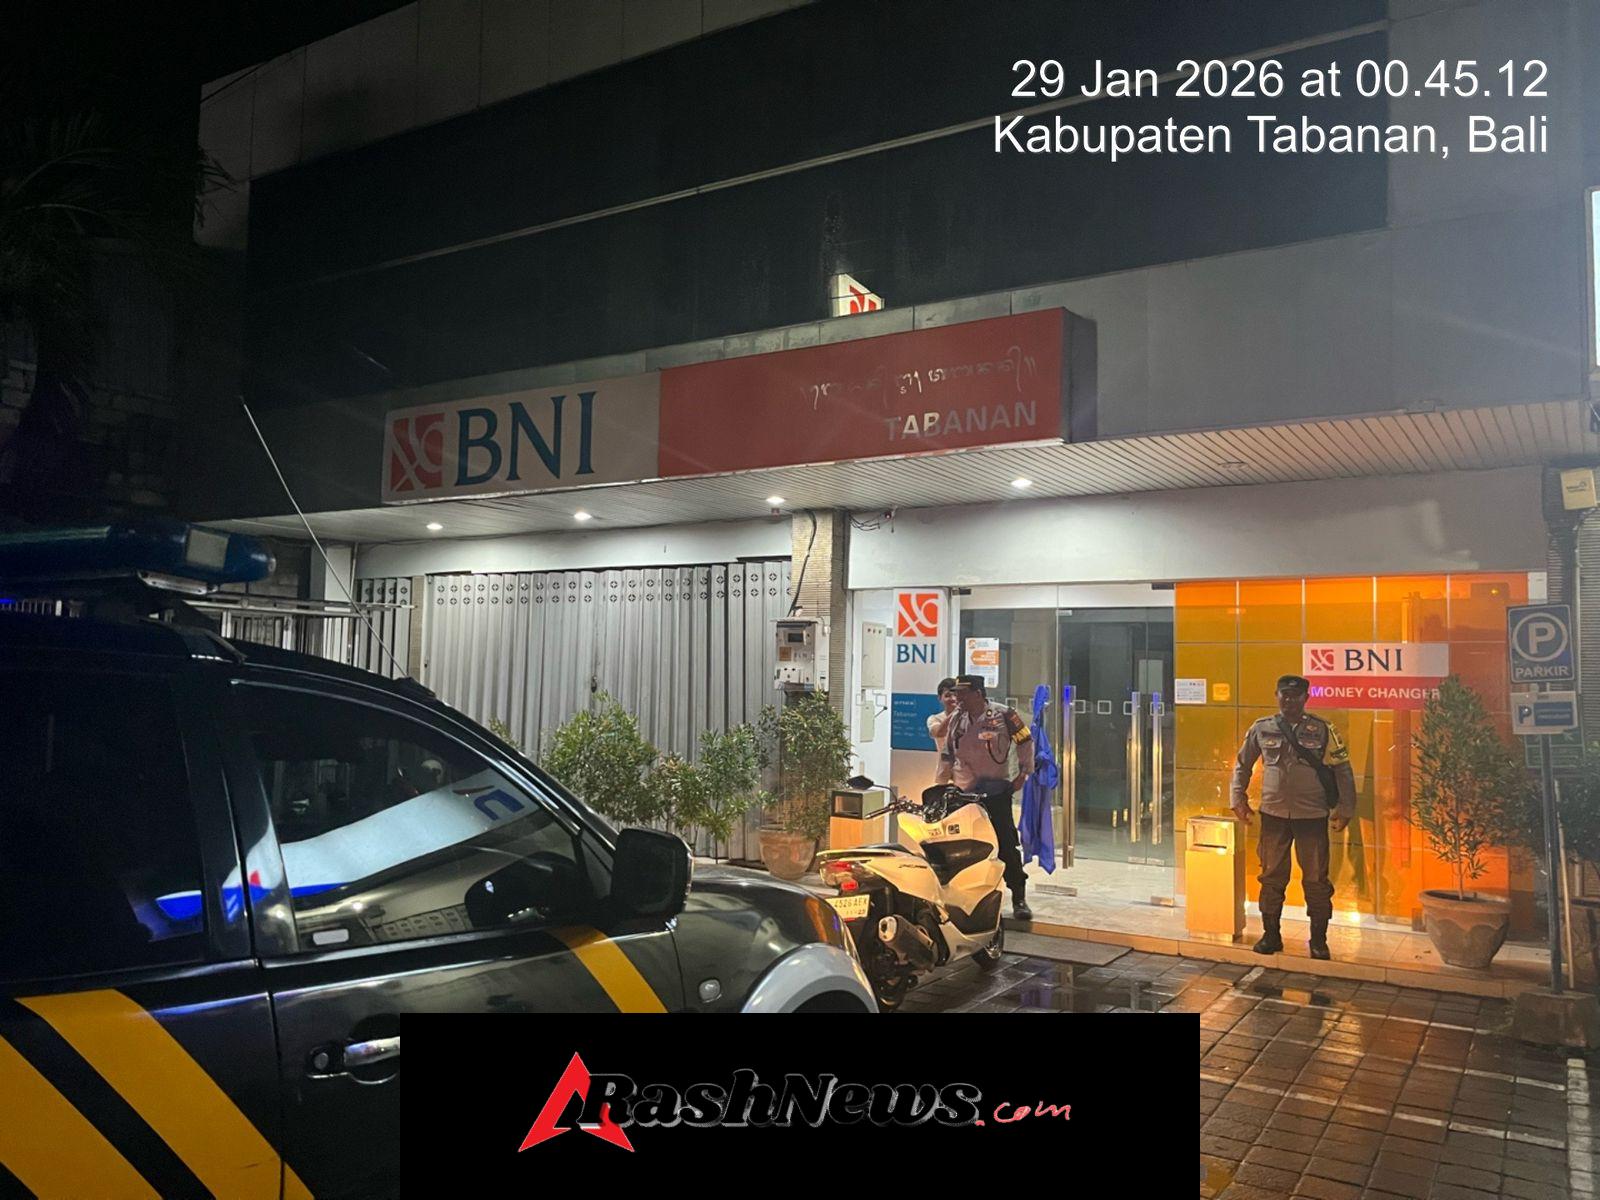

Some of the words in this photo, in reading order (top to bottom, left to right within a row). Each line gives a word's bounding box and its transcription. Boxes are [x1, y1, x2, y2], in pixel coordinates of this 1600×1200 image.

[883, 400, 1037, 442] TABANAN
[455, 391, 596, 487] BNI
[1527, 621, 1556, 655] P
[896, 643, 936, 664] BNI
[1344, 648, 1402, 671] BNI
[1515, 664, 1570, 679] PARKIR
[1310, 686, 1364, 698] MONEY
